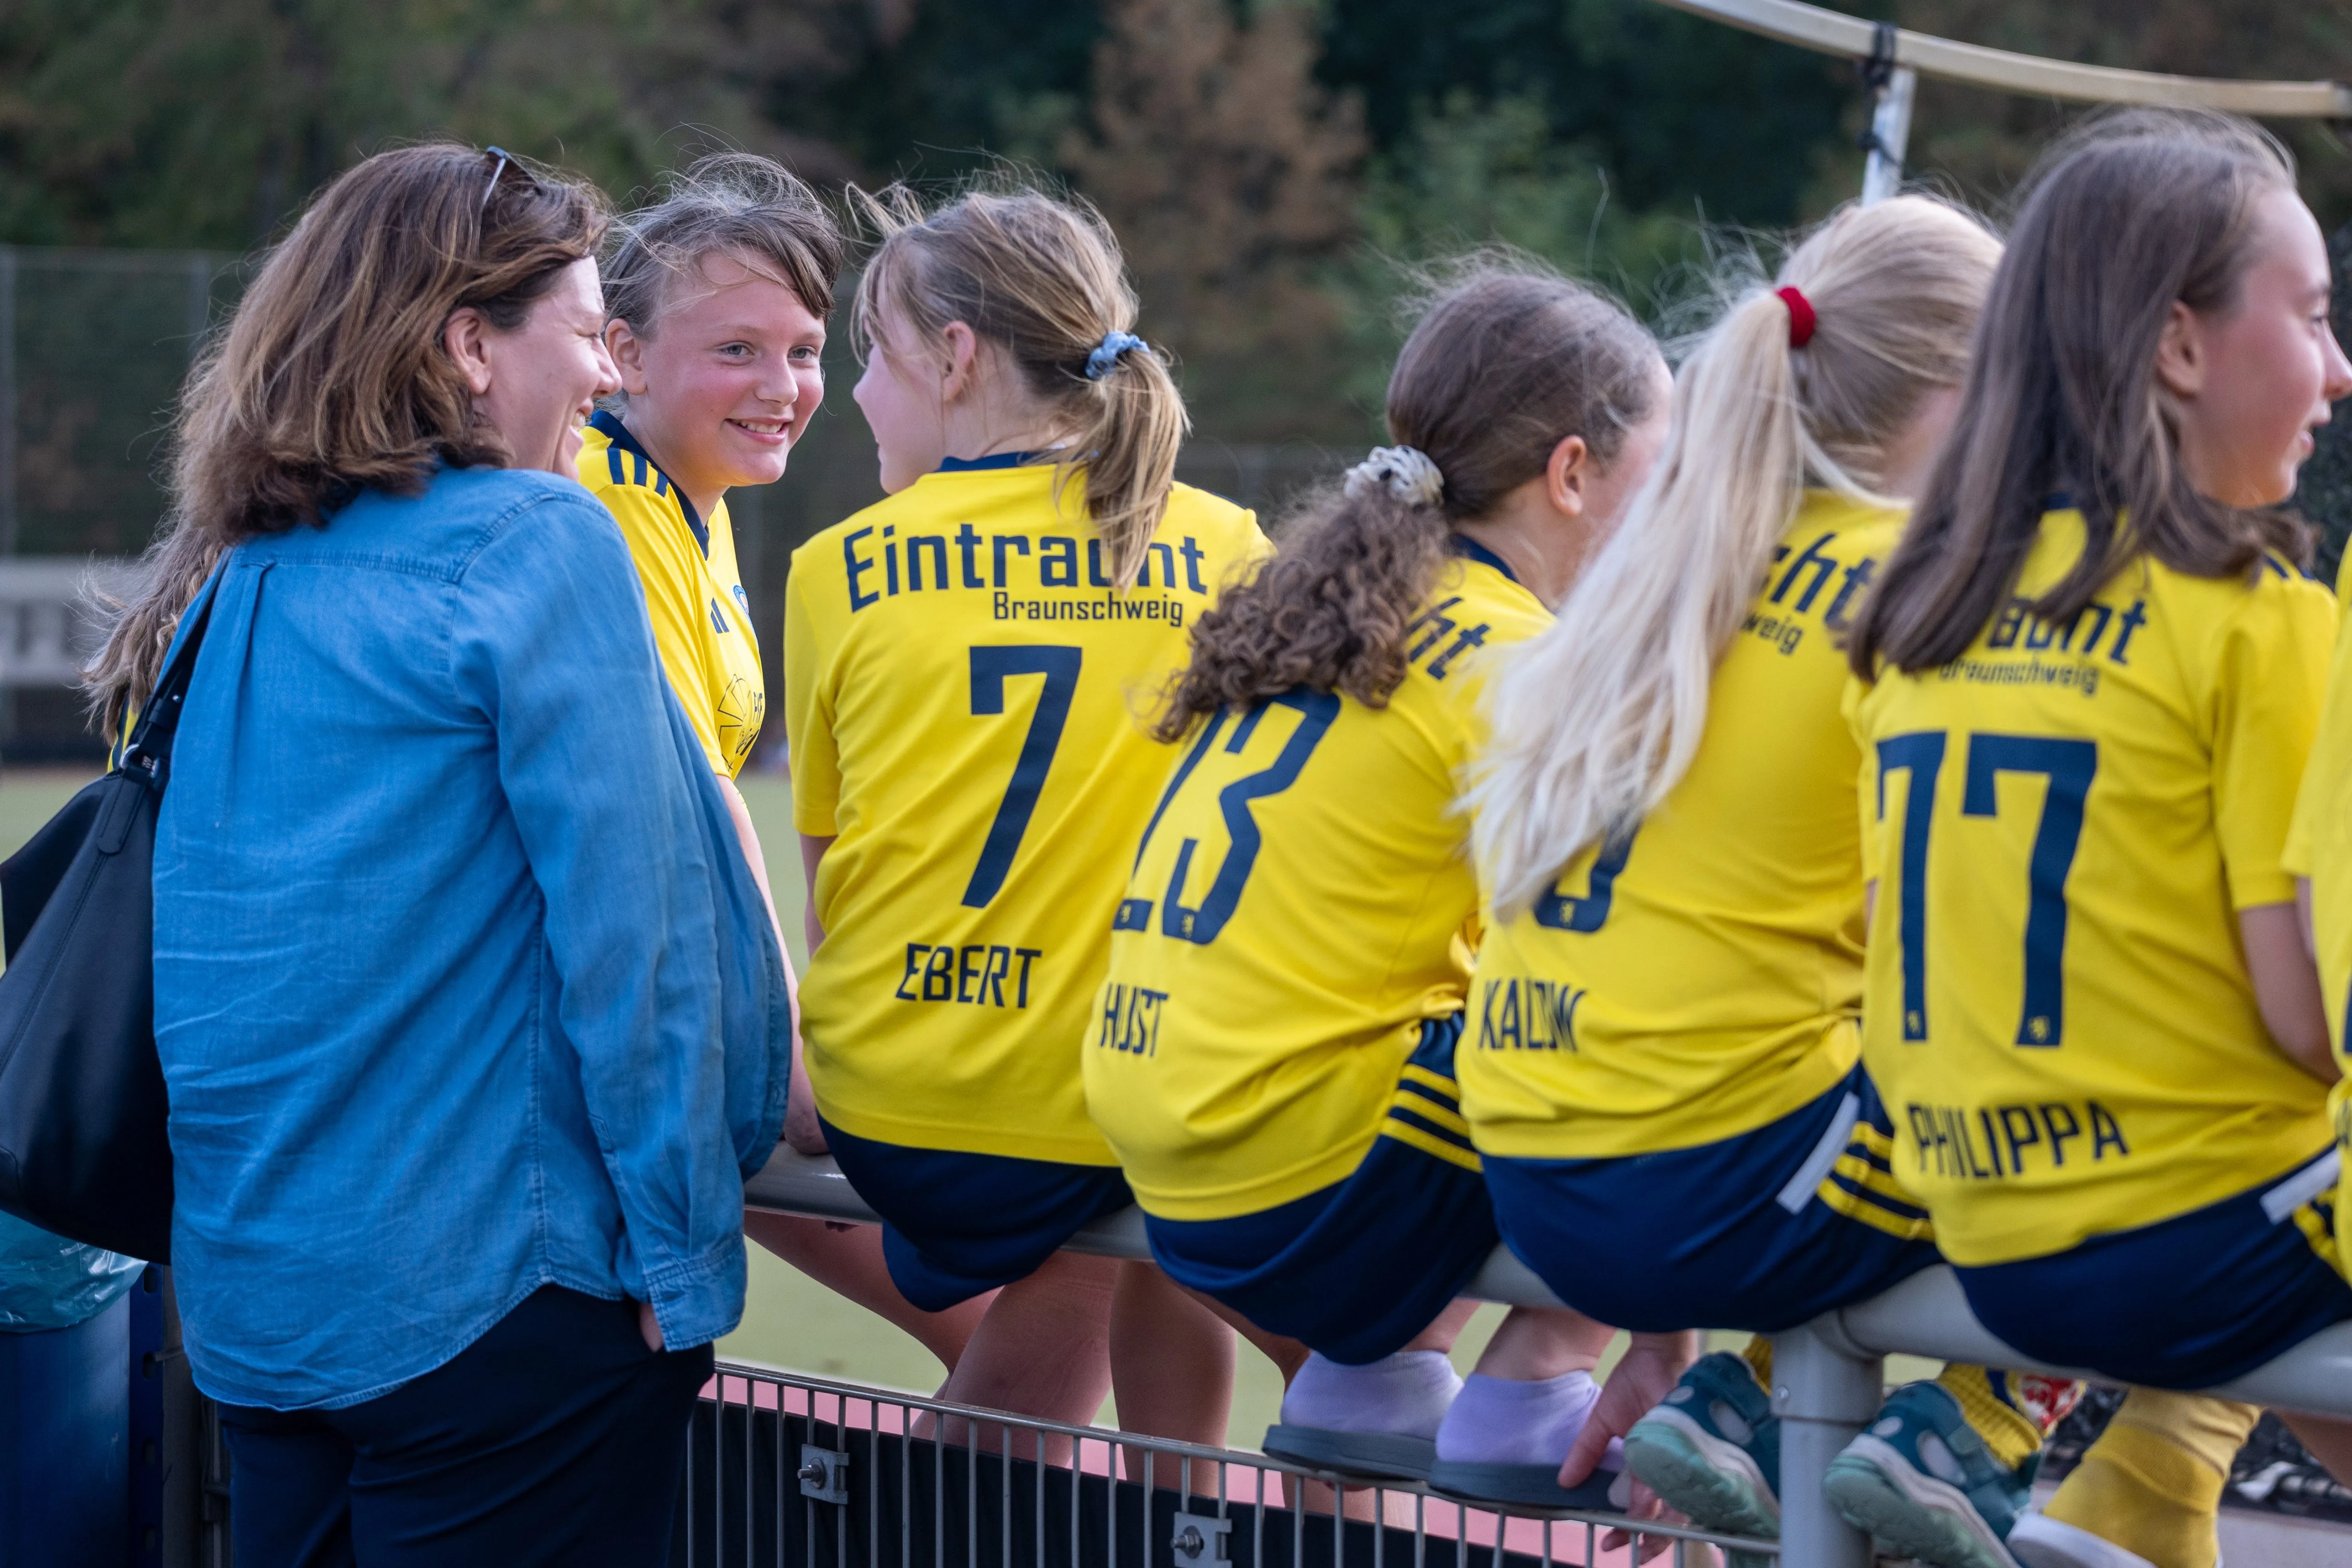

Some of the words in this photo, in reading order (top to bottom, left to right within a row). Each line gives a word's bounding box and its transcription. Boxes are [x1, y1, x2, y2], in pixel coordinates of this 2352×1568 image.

[843, 523, 1208, 612] Eintracht
[993, 592, 1183, 627] Braunschweig
[961, 645, 1083, 909] 7
[1876, 730, 2097, 1046] 77
[896, 942, 1041, 1008] EBERT
[1099, 981, 1170, 1058] HUST
[1907, 1101, 2129, 1179] PHILIPPA
